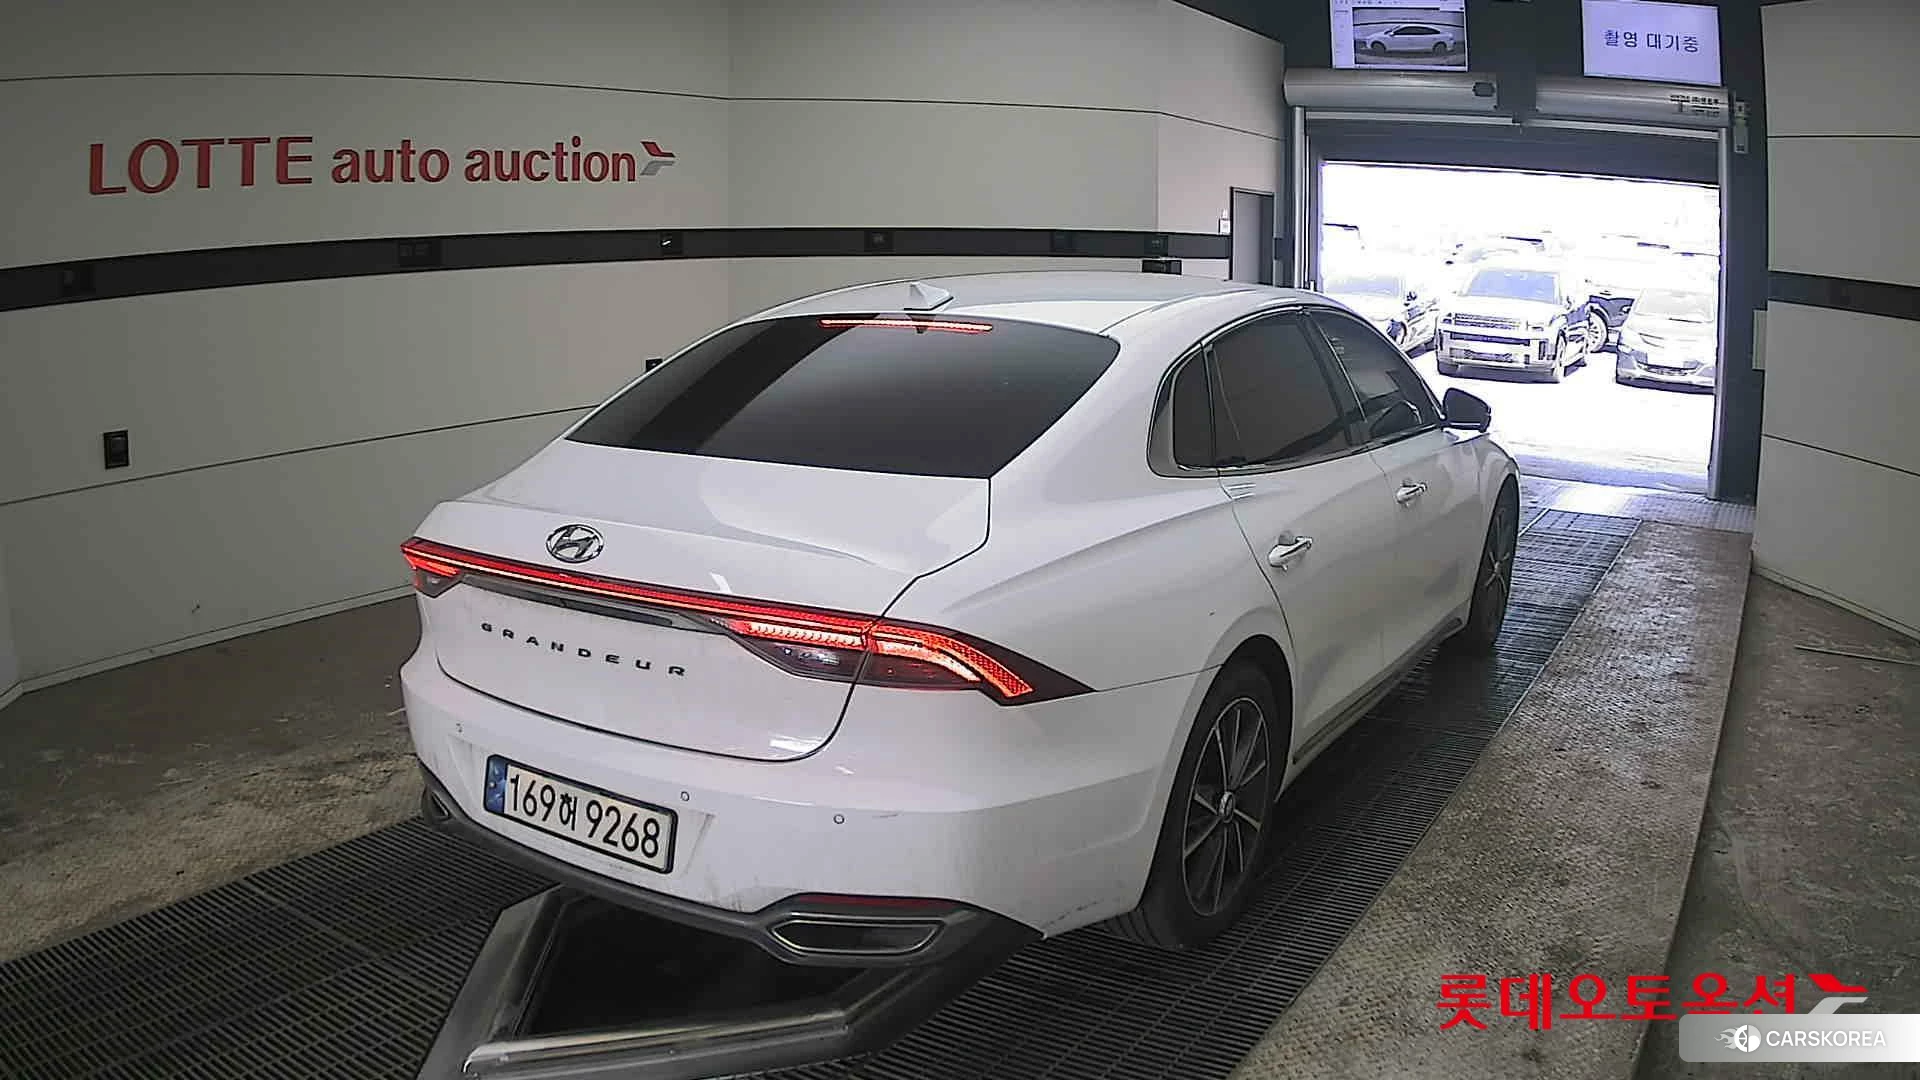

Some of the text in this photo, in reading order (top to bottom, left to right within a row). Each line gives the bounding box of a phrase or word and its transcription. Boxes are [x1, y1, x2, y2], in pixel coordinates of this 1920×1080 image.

[1605, 30, 1698, 53] 촬영 대기중
[90, 135, 636, 195] LOTTE auto auction
[481, 622, 686, 677] GRANDEUR
[510, 774, 661, 859] 169허 9268
